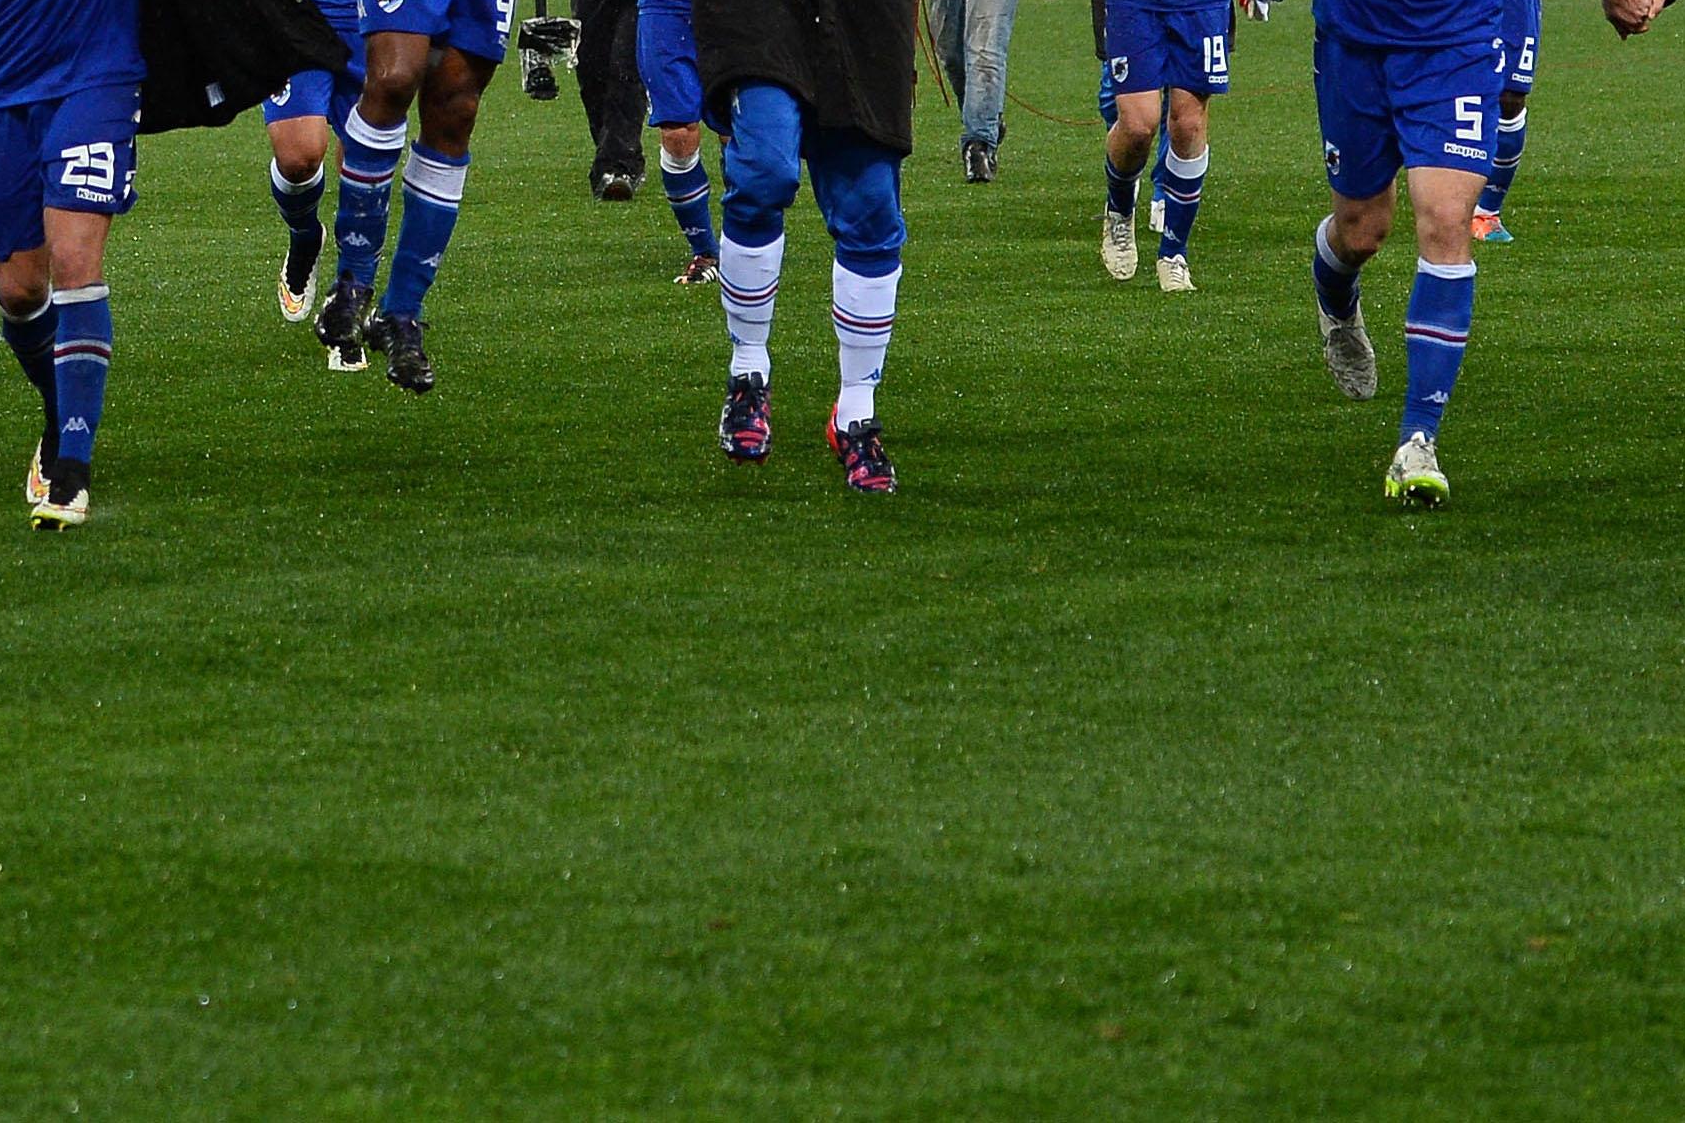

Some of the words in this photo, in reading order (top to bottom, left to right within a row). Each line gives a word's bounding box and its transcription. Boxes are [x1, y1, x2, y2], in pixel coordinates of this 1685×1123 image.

[1203, 35, 1228, 73] 19
[1518, 36, 1535, 71] 6
[1455, 95, 1483, 141] 5
[60, 141, 115, 191] 23
[1444, 142, 1488, 160] Kappa
